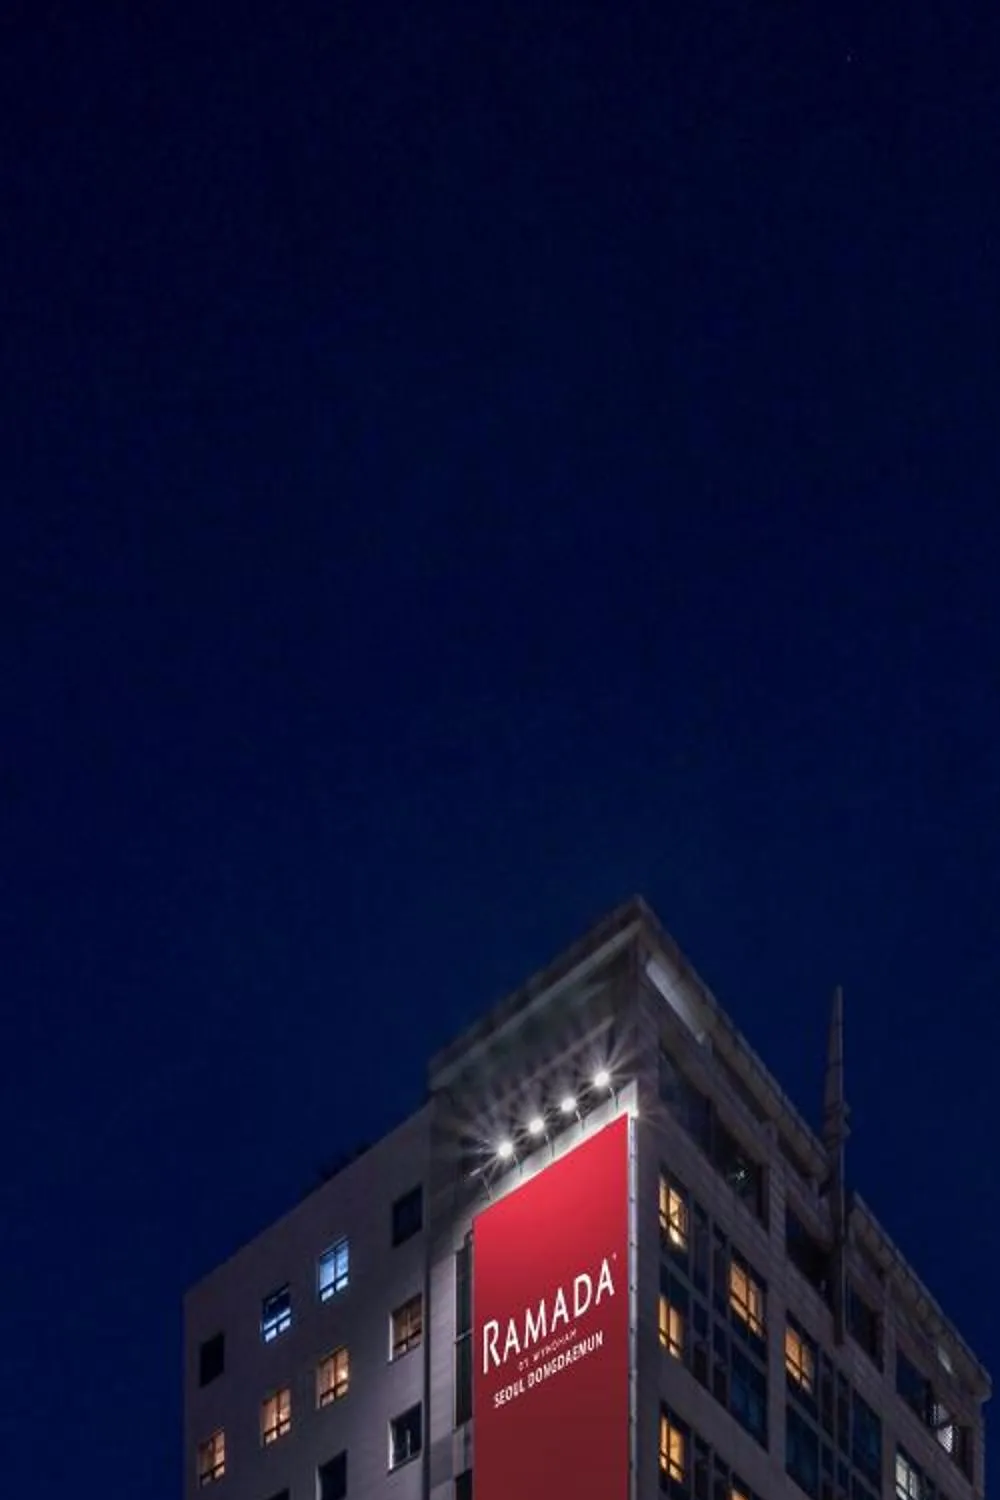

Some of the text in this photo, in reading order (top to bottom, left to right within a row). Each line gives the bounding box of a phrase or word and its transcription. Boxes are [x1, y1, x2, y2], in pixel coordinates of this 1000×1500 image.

[483, 1257, 615, 1375] RAMADA
[494, 1330, 604, 1409] SEOUL DONGDAEMUN
